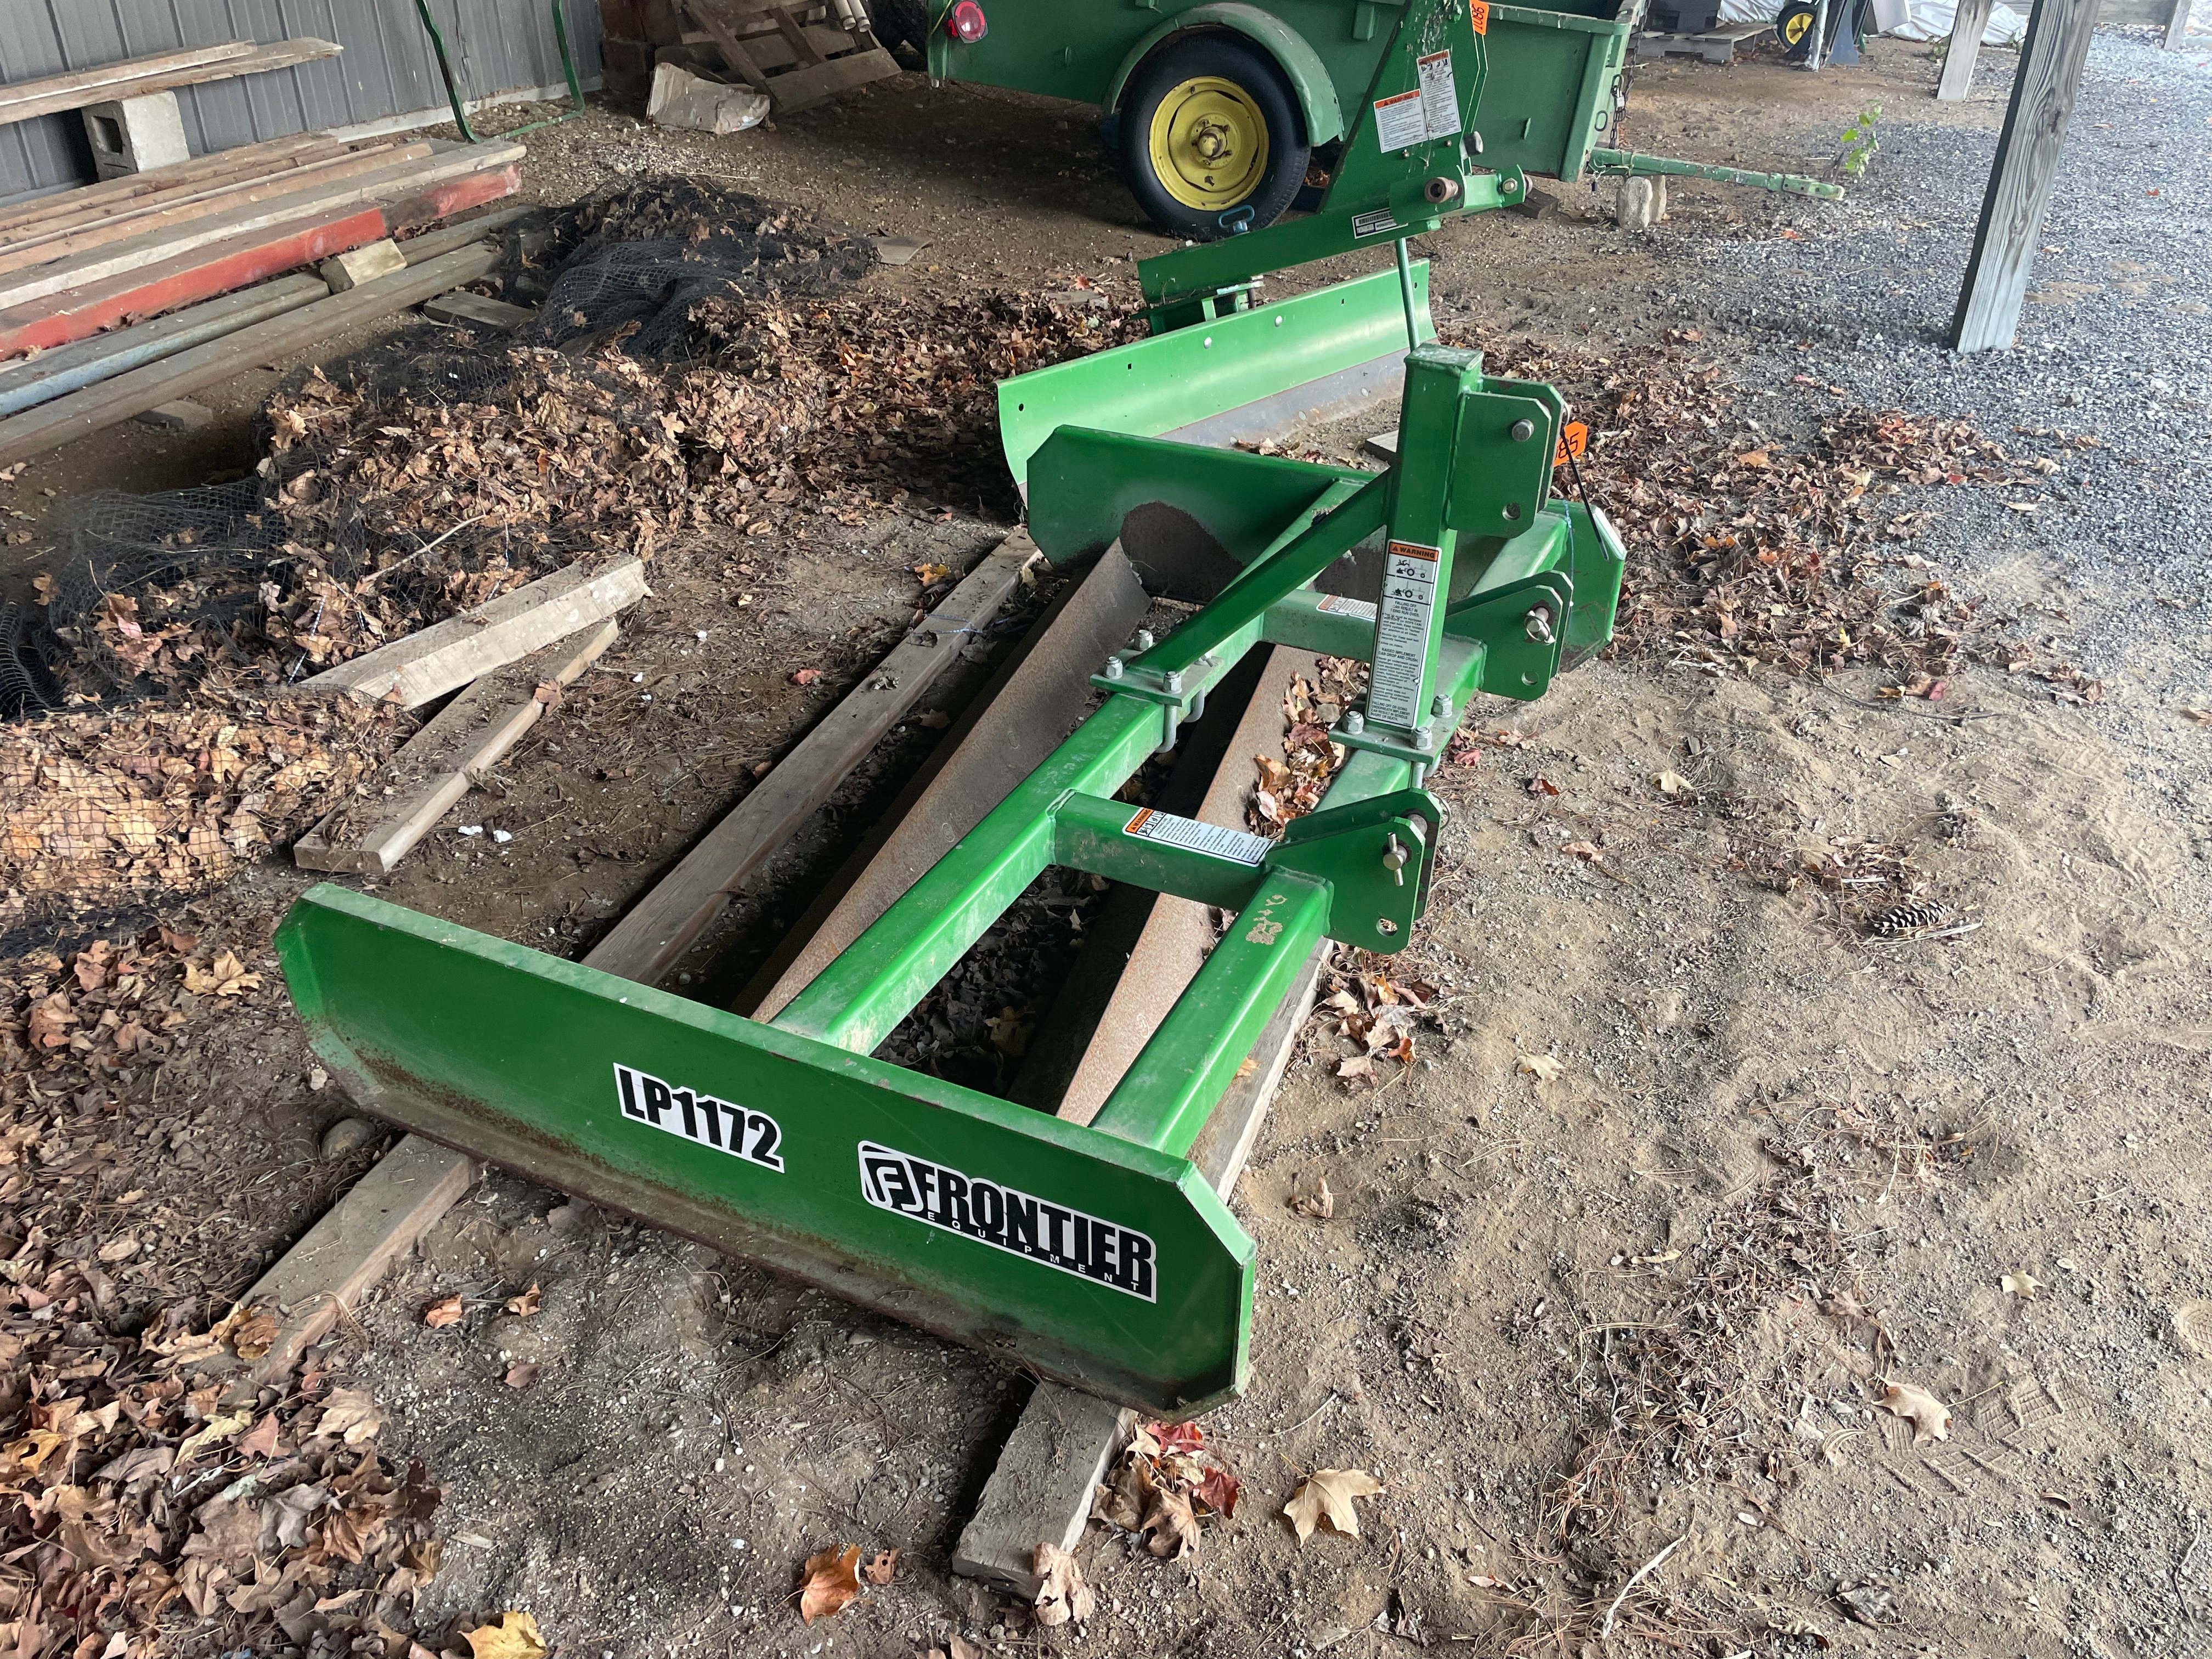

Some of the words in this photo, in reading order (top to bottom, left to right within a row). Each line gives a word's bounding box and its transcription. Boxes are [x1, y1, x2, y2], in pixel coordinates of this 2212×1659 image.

[1400, 547, 1435, 558] WARNING
[618, 1068, 780, 1167] LP1172
[907, 1158, 1152, 1283] FRONTIER
[928, 1211, 1138, 1291] EQUIPMENT
